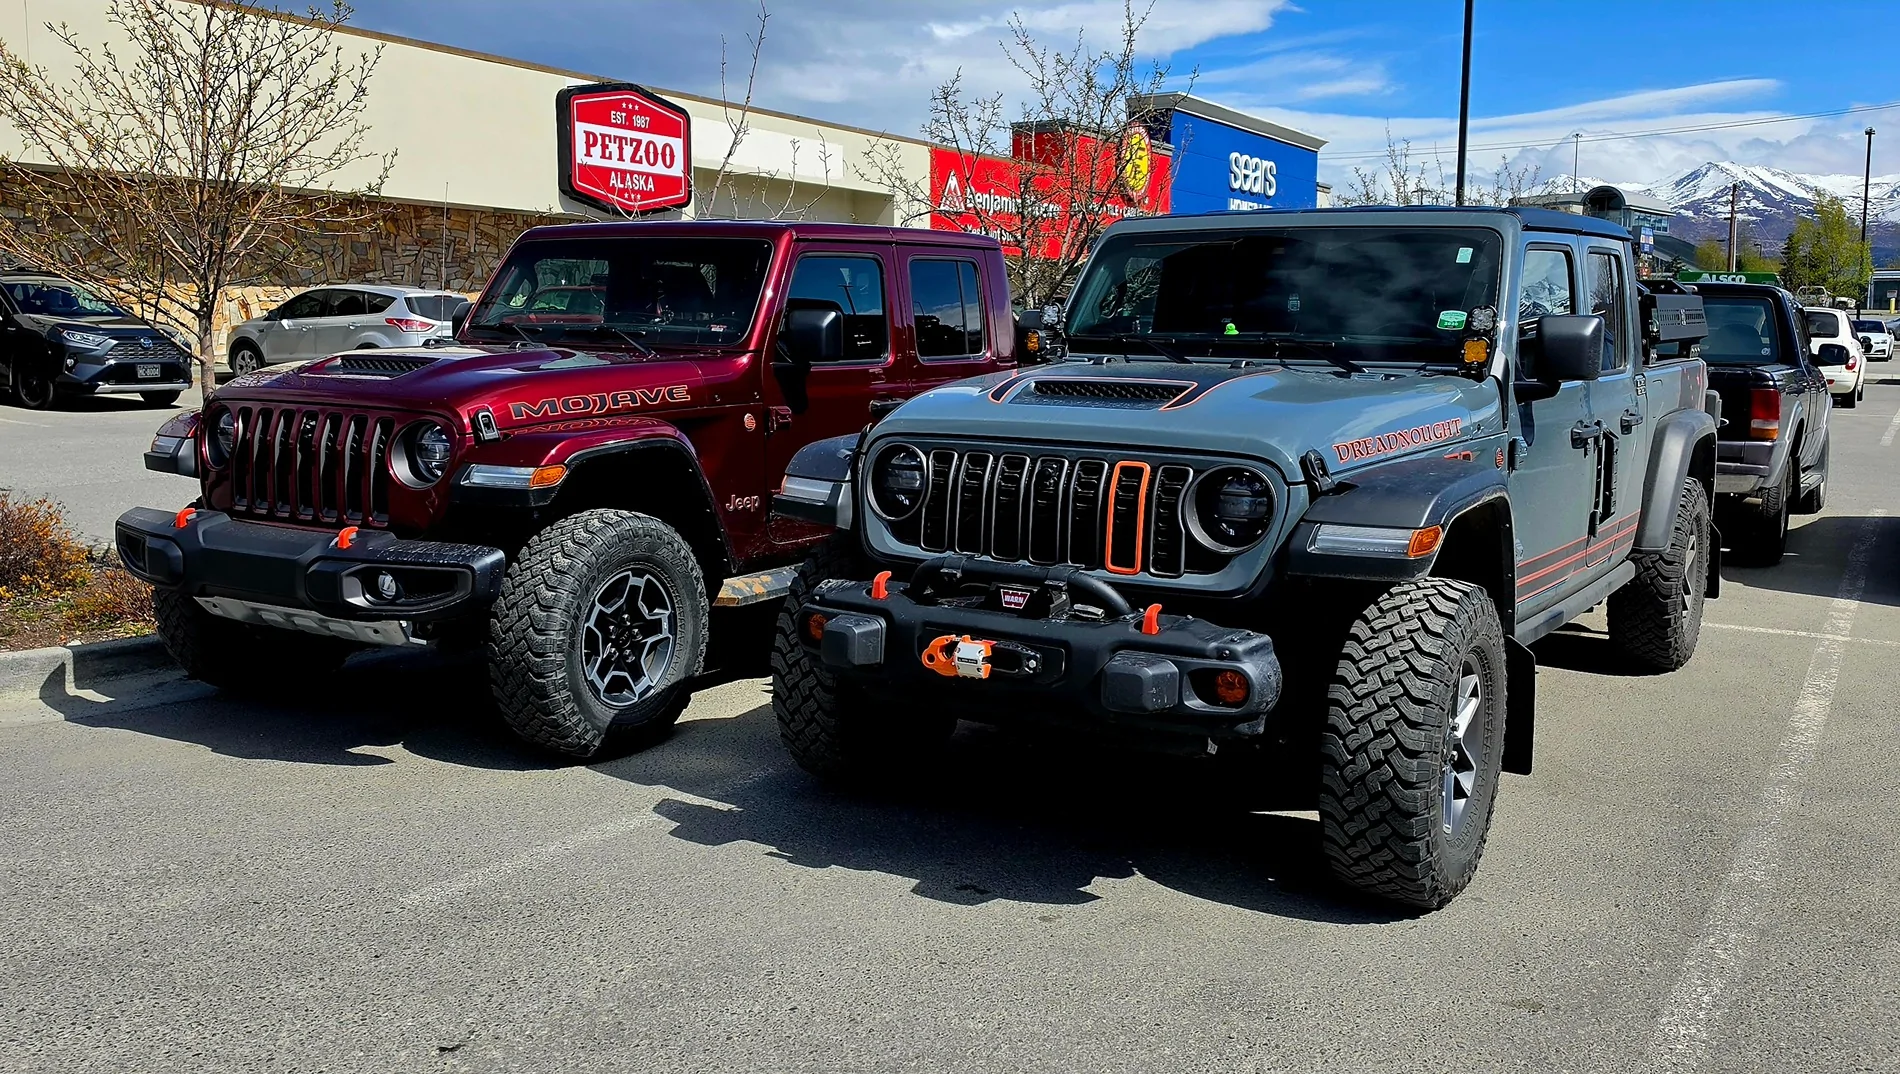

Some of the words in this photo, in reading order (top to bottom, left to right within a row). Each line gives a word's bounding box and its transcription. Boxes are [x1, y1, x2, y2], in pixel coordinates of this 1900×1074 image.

[610, 110, 629, 126] EST.
[632, 115, 650, 129] 1987
[583, 129, 676, 170] PETZOO
[609, 170, 655, 192] ALASKA
[1229, 151, 1277, 197] sears
[965, 184, 1022, 217] Benjamin
[1022, 192, 1062, 220] oore
[981, 226, 1000, 240] Pint
[1697, 272, 1747, 284] ALSCO
[508, 384, 691, 420] MOJAVE
[1332, 417, 1462, 463] DREADNOUGHT
[726, 494, 760, 512] Jeep
[1004, 594, 1024, 603] WARN
